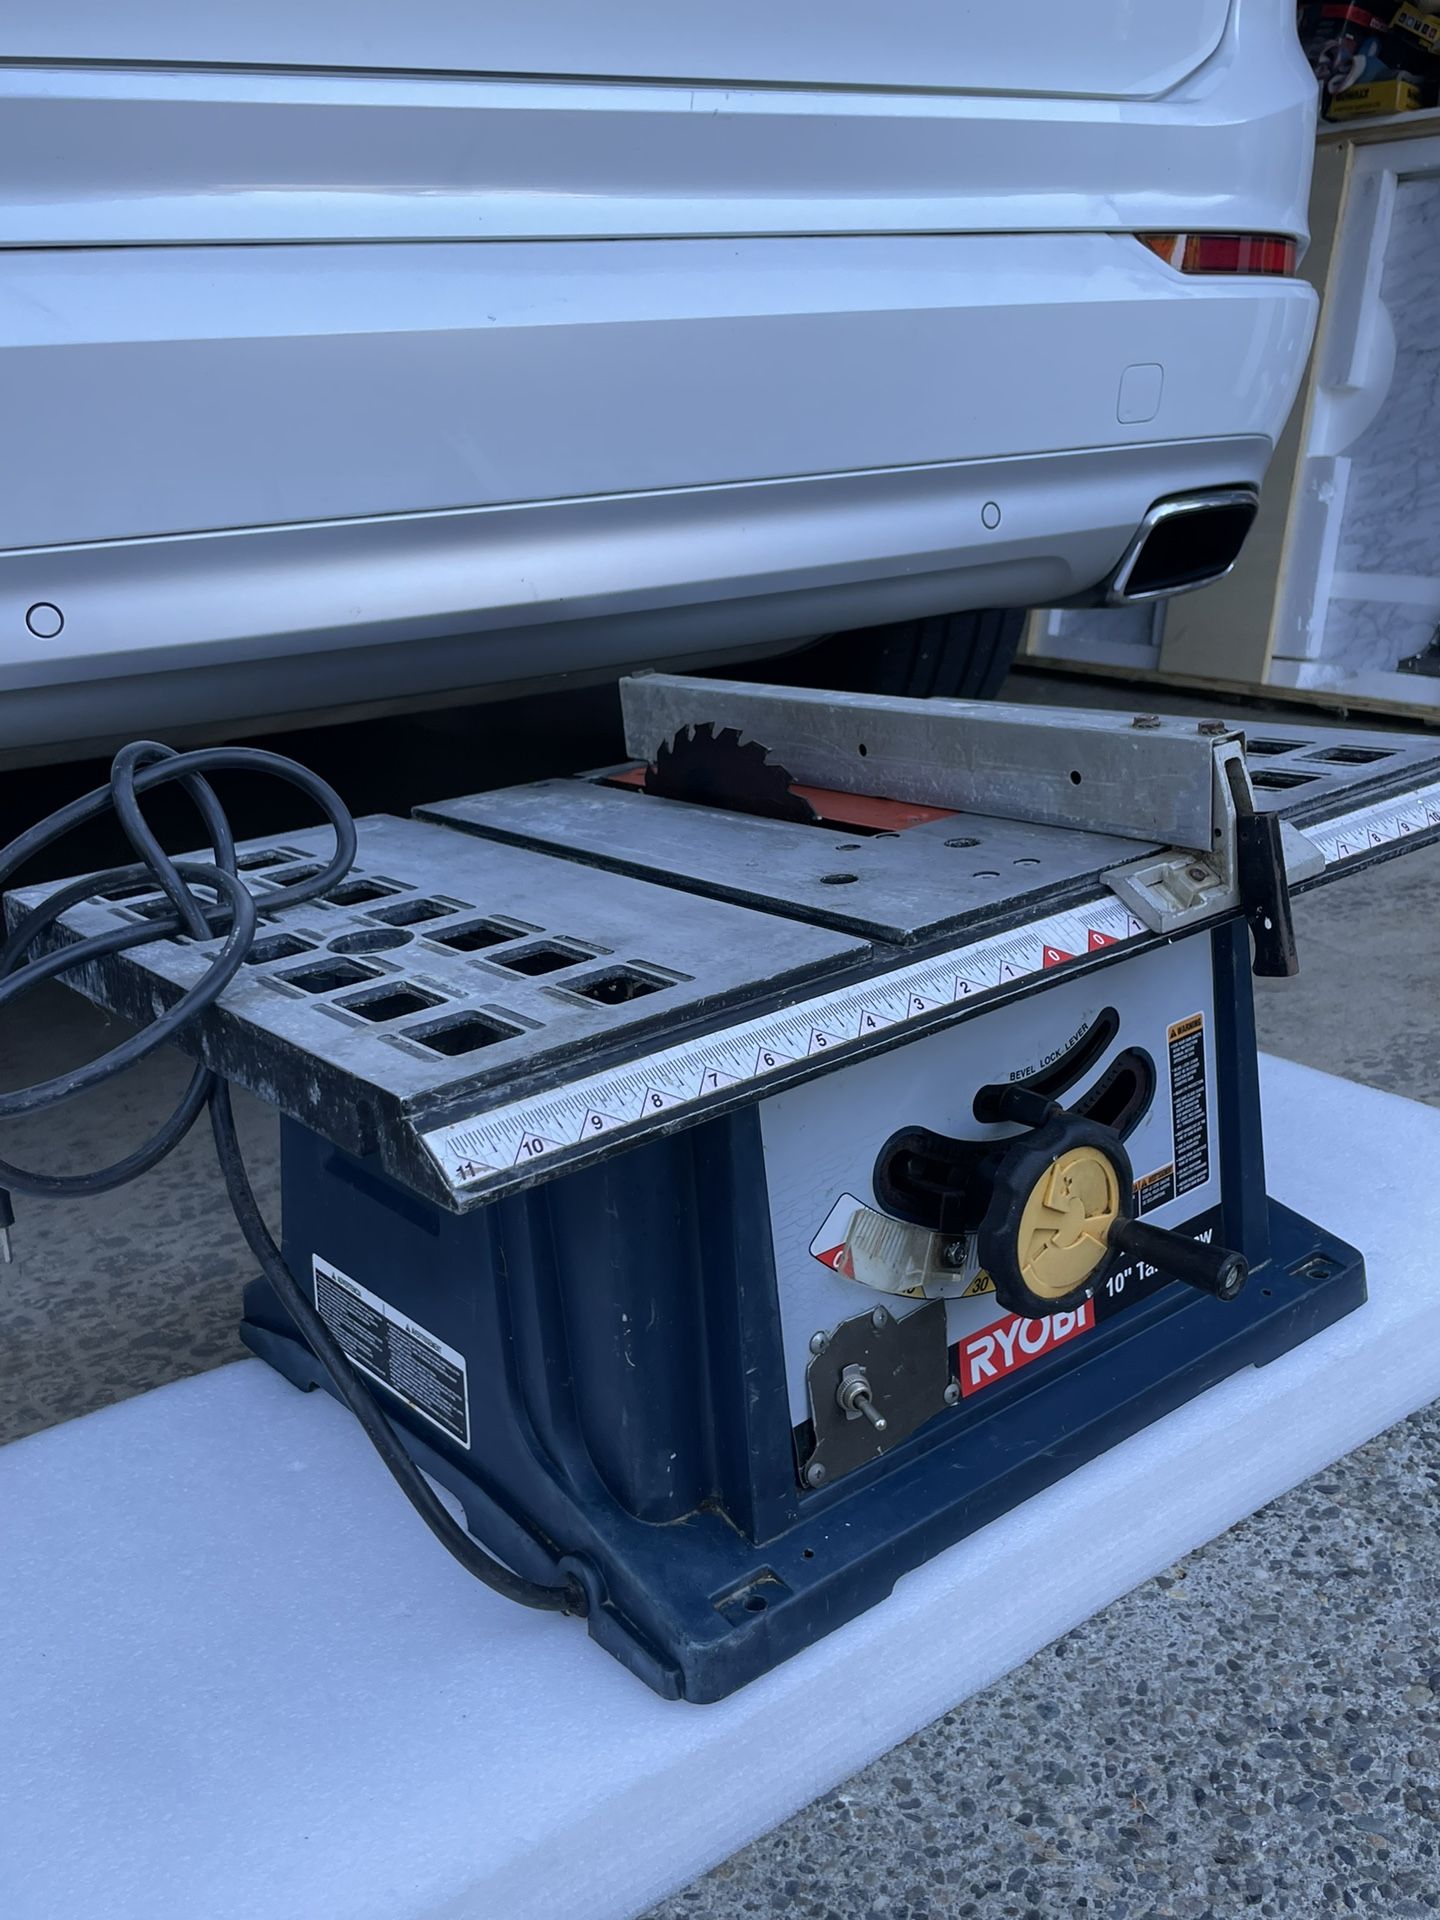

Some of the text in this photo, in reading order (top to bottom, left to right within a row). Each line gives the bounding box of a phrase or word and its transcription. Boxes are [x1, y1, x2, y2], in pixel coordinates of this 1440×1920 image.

[1340, 844, 1350, 855] 7
[1371, 833, 1381, 843] 8
[1401, 822, 1410, 832] 9
[455, 919, 1142, 1181] 11 10 9 8 7 6 5 4 3 2 1 0 0 1
[1009, 1022, 1089, 1081] BEVEL LOCK LEVER
[971, 1276, 990, 1293] 30
[1105, 1267, 1133, 1297] 10"
[967, 1300, 1086, 1385] RYOBI
